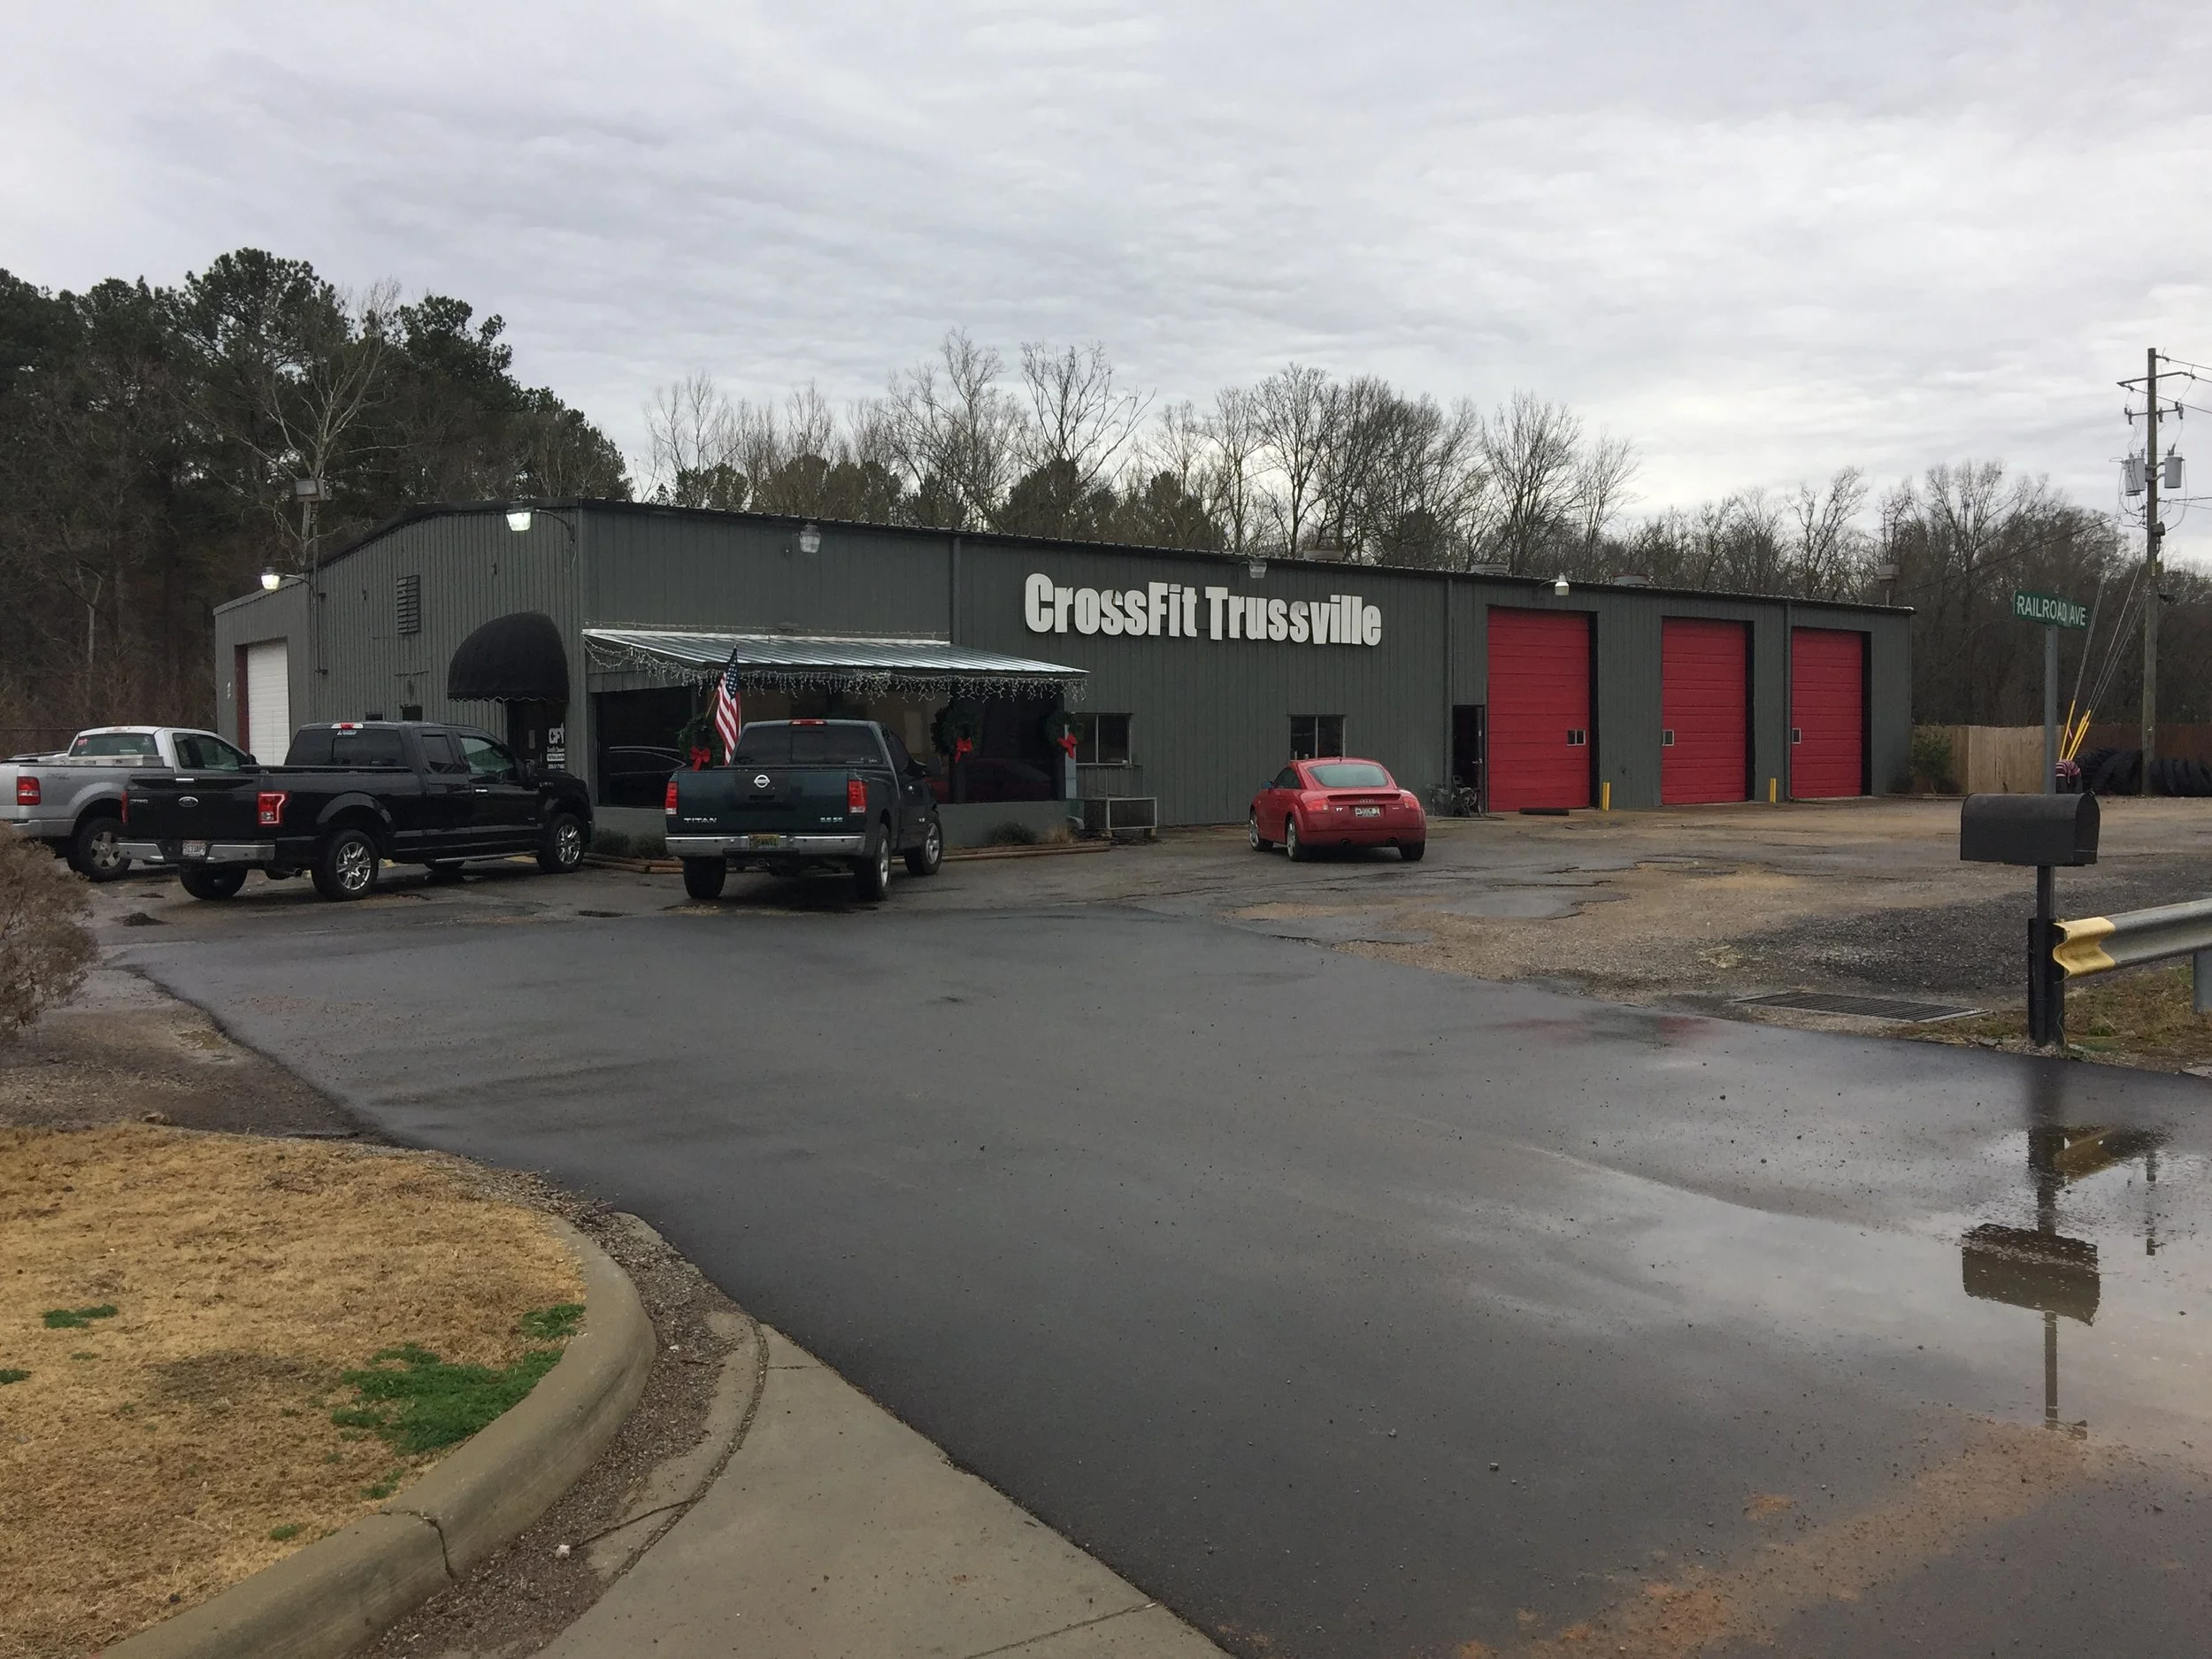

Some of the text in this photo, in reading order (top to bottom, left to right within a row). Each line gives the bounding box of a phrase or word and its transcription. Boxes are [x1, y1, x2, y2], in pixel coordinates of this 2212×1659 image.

[1025, 572, 1382, 647] CrossFit Trussville
[2016, 595, 2086, 626] RAILROAD AVE
